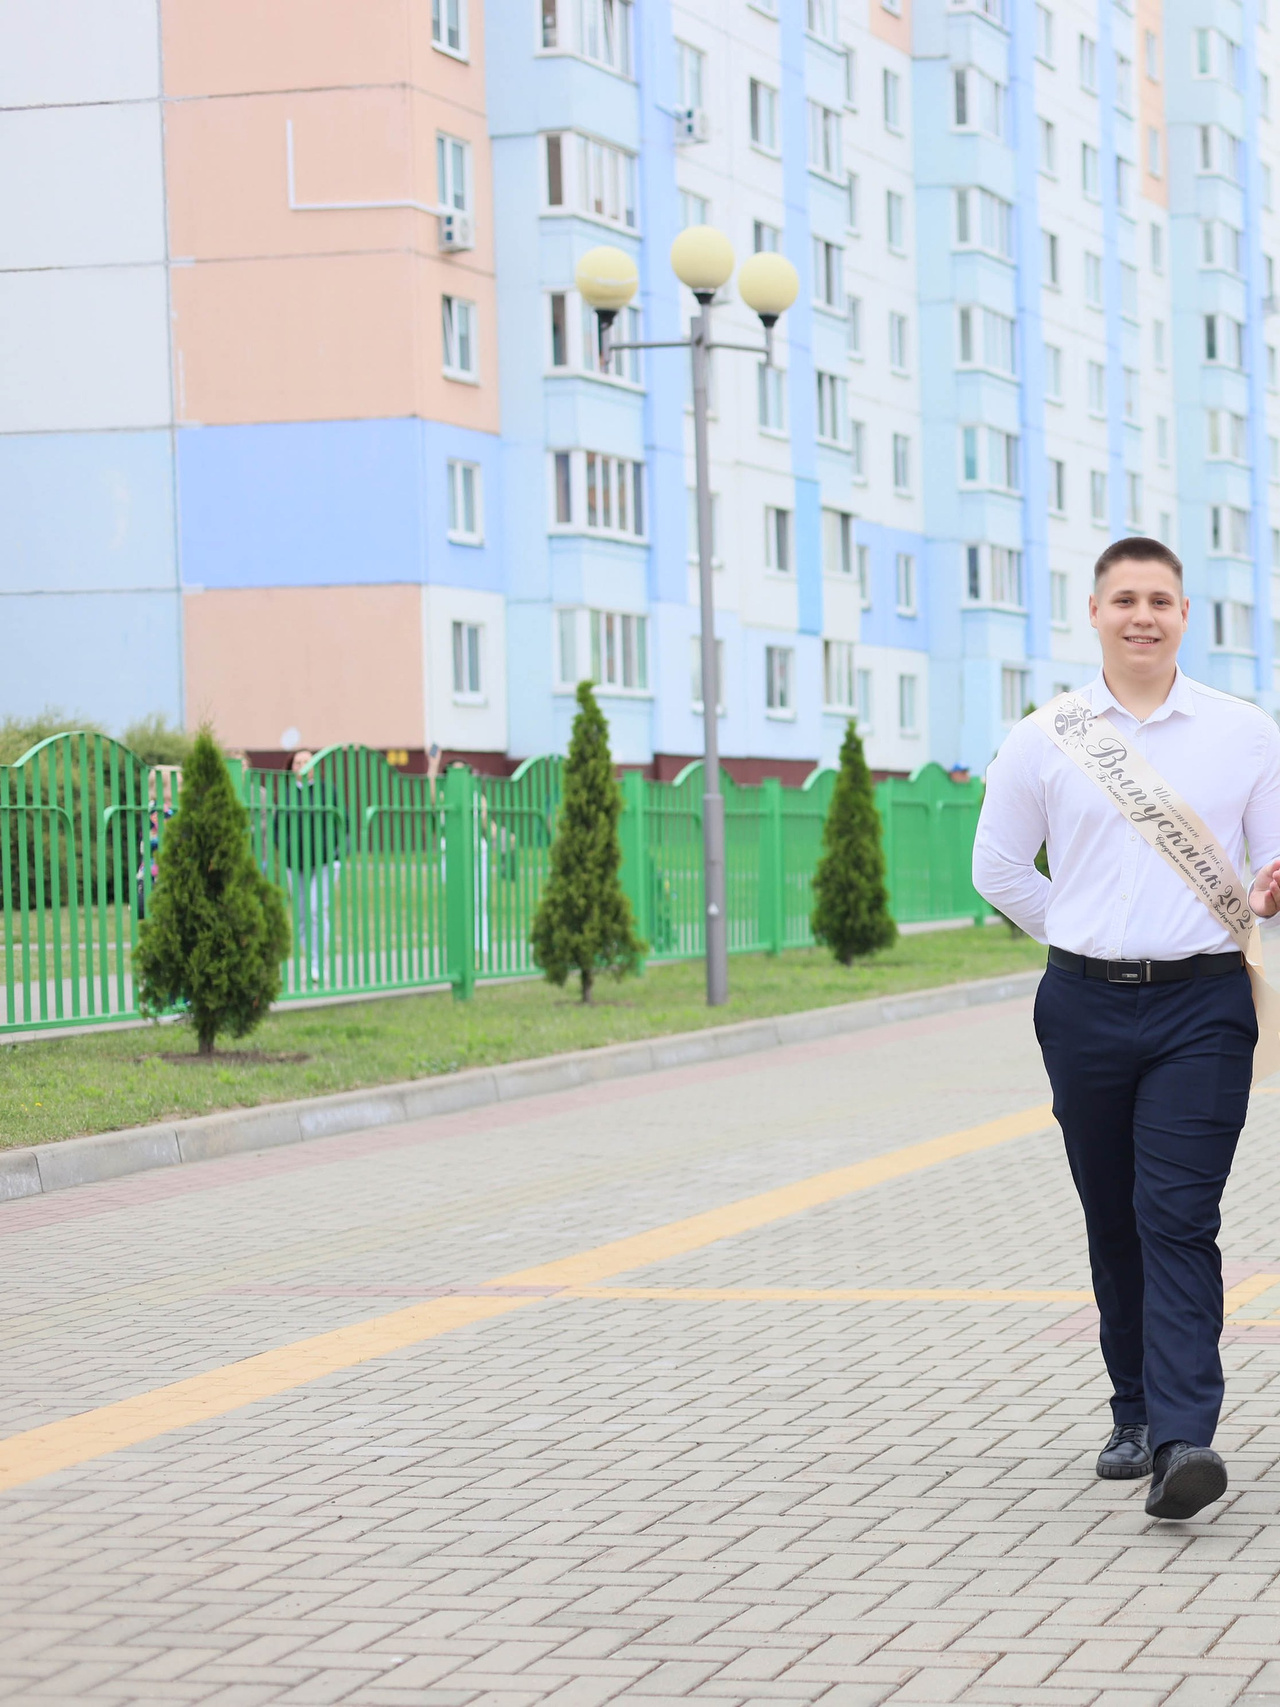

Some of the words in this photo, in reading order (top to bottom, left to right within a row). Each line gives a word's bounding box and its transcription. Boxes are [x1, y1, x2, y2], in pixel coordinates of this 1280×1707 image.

[1084, 761, 1094, 769] 11
[1106, 785, 1127, 806] класс
[1086, 737, 1221, 890] Выпускник
[1155, 833, 1180, 863] Средняя
[1179, 863, 1197, 883] школа
